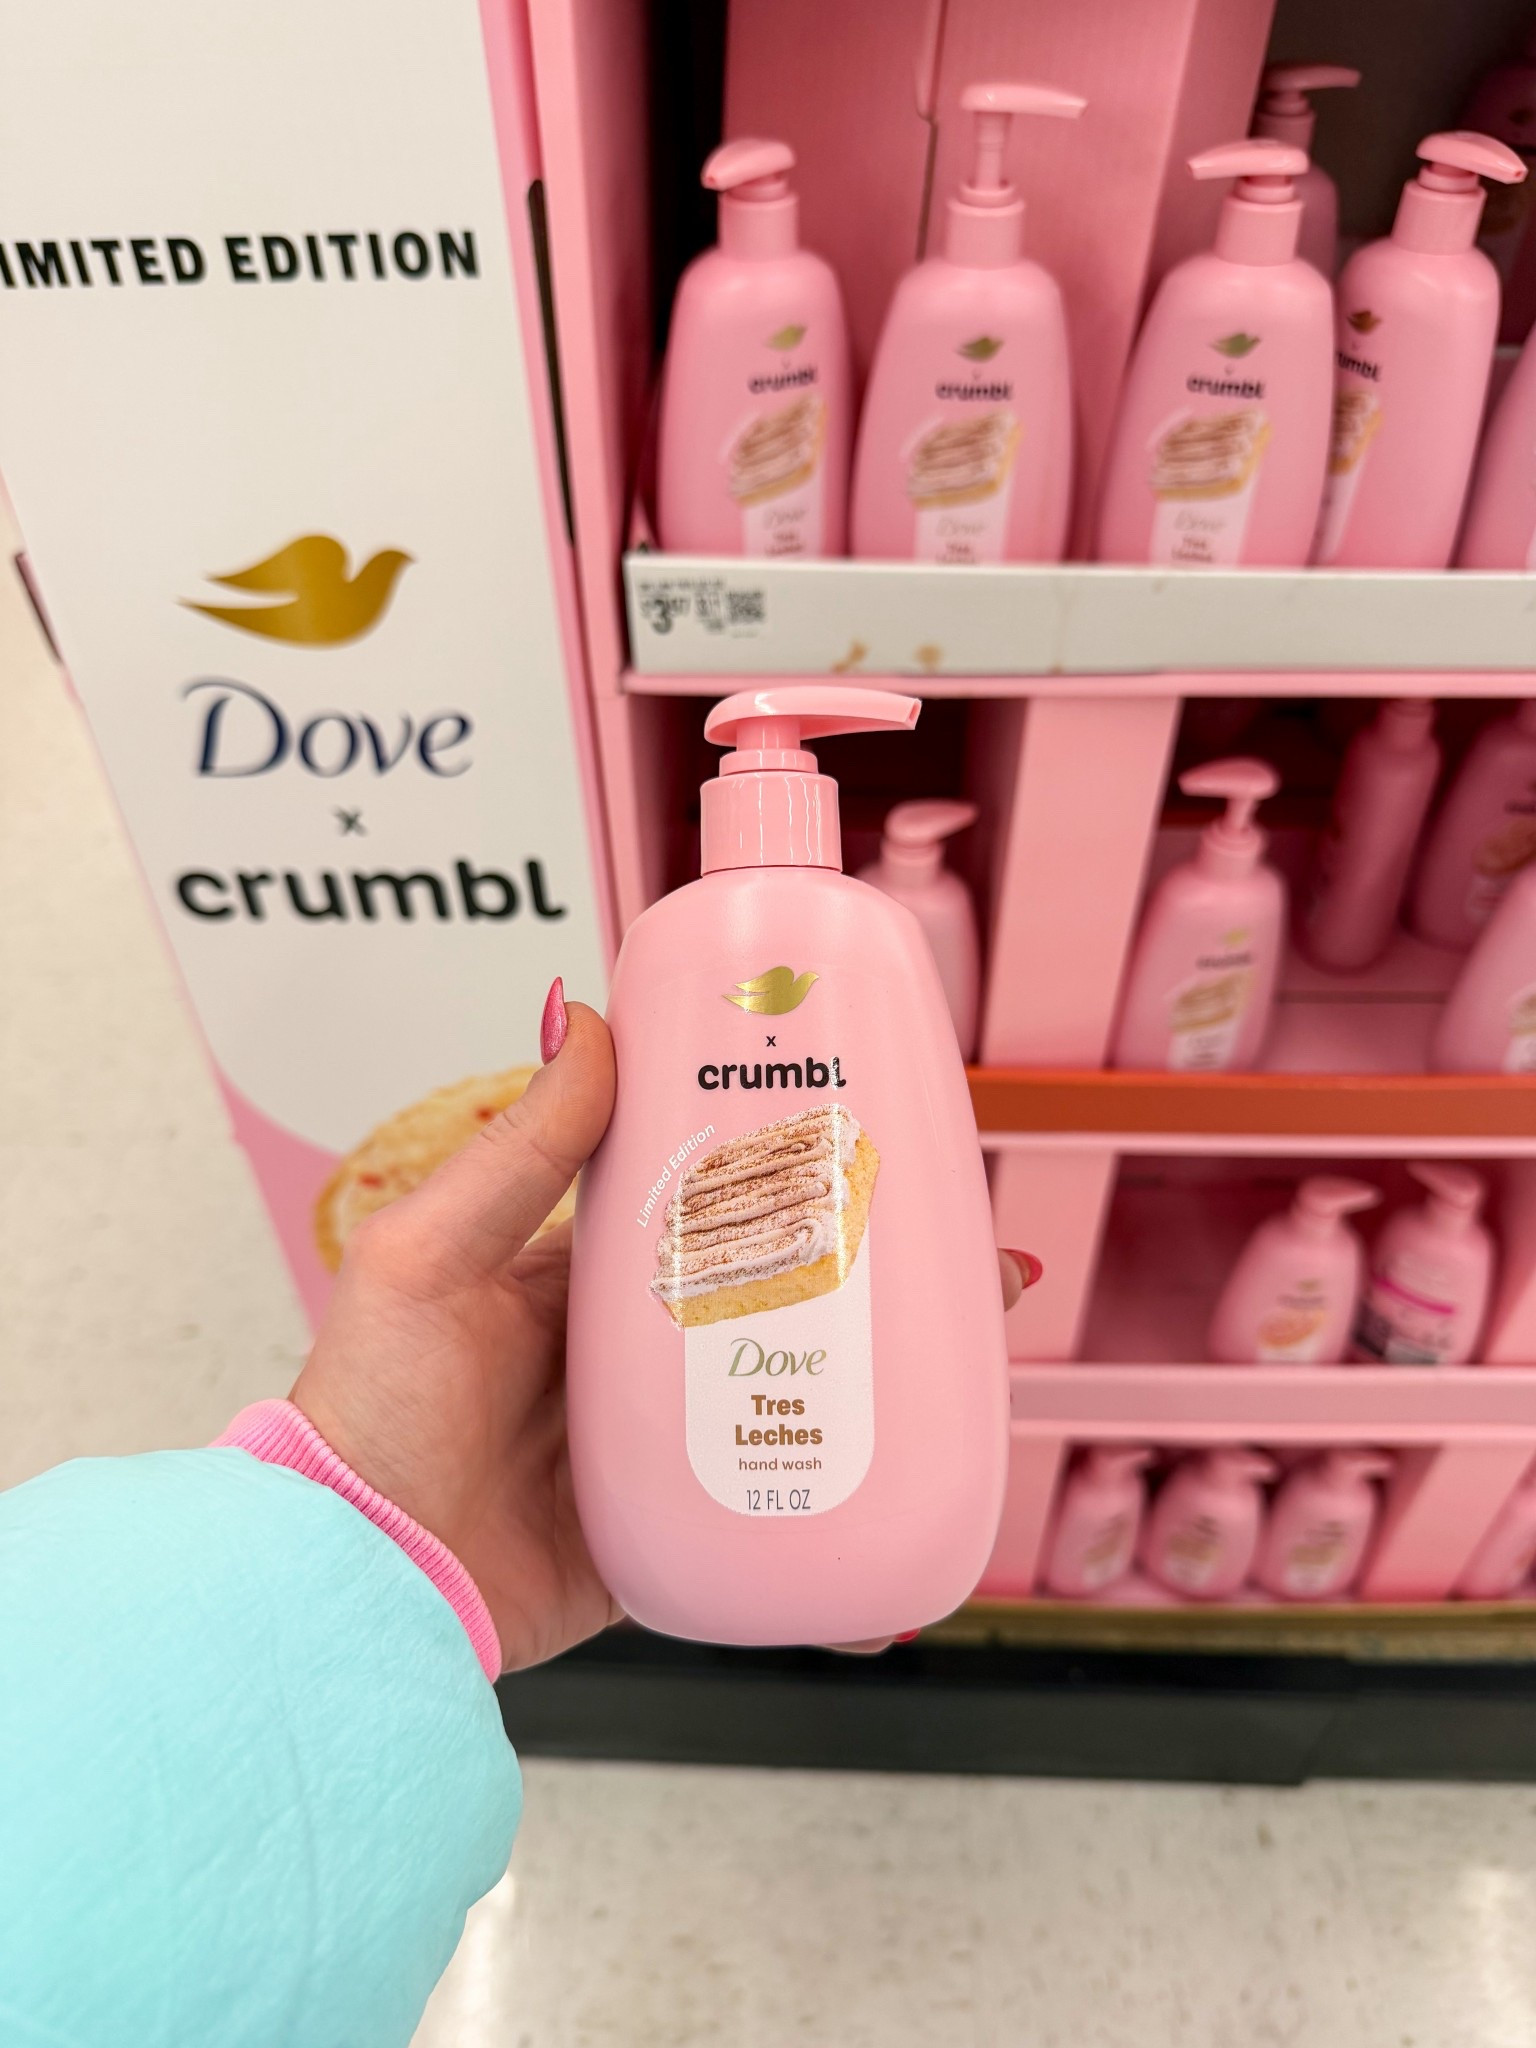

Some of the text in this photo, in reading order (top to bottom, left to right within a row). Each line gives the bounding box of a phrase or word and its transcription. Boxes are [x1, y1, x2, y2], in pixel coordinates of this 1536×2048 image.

[0, 230, 480, 290] IMITED EDITION
[181, 676, 475, 780] Dove
[334, 808, 366, 837] x
[176, 857, 569, 924] crumbl
[766, 1035, 777, 1048] x
[697, 1056, 847, 1091] crumbl
[636, 1123, 716, 1229] Limited Edition
[727, 1337, 828, 1377] Dove
[750, 1394, 806, 1416] Tres
[735, 1423, 824, 1446] Leches
[738, 1457, 823, 1471] hand wash
[746, 1489, 812, 1511] 12 FL OZ
